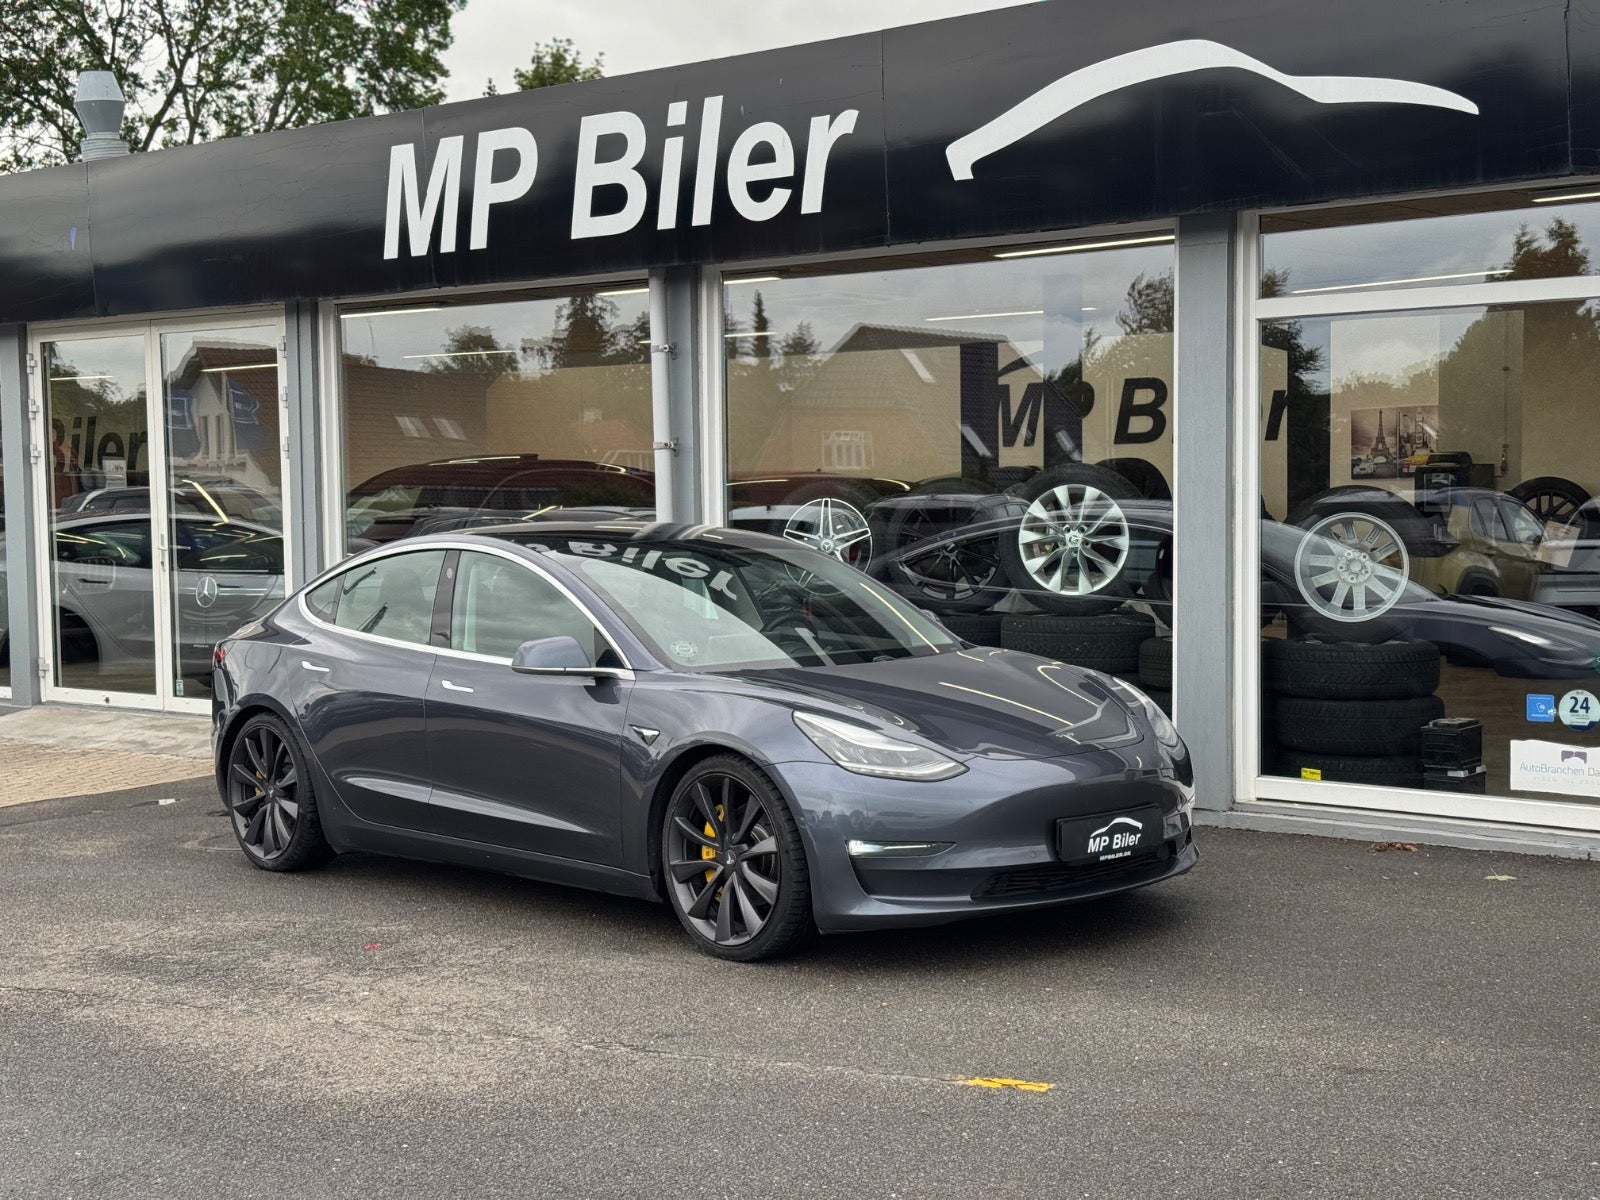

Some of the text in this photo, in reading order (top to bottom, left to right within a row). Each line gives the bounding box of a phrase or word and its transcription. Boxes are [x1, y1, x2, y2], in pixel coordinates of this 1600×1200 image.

[383, 95, 860, 260] MP Biler
[1569, 695, 1591, 714] 24
[1520, 762, 1585, 776] AutoBranchen
[1087, 832, 1142, 854] MP Biler
